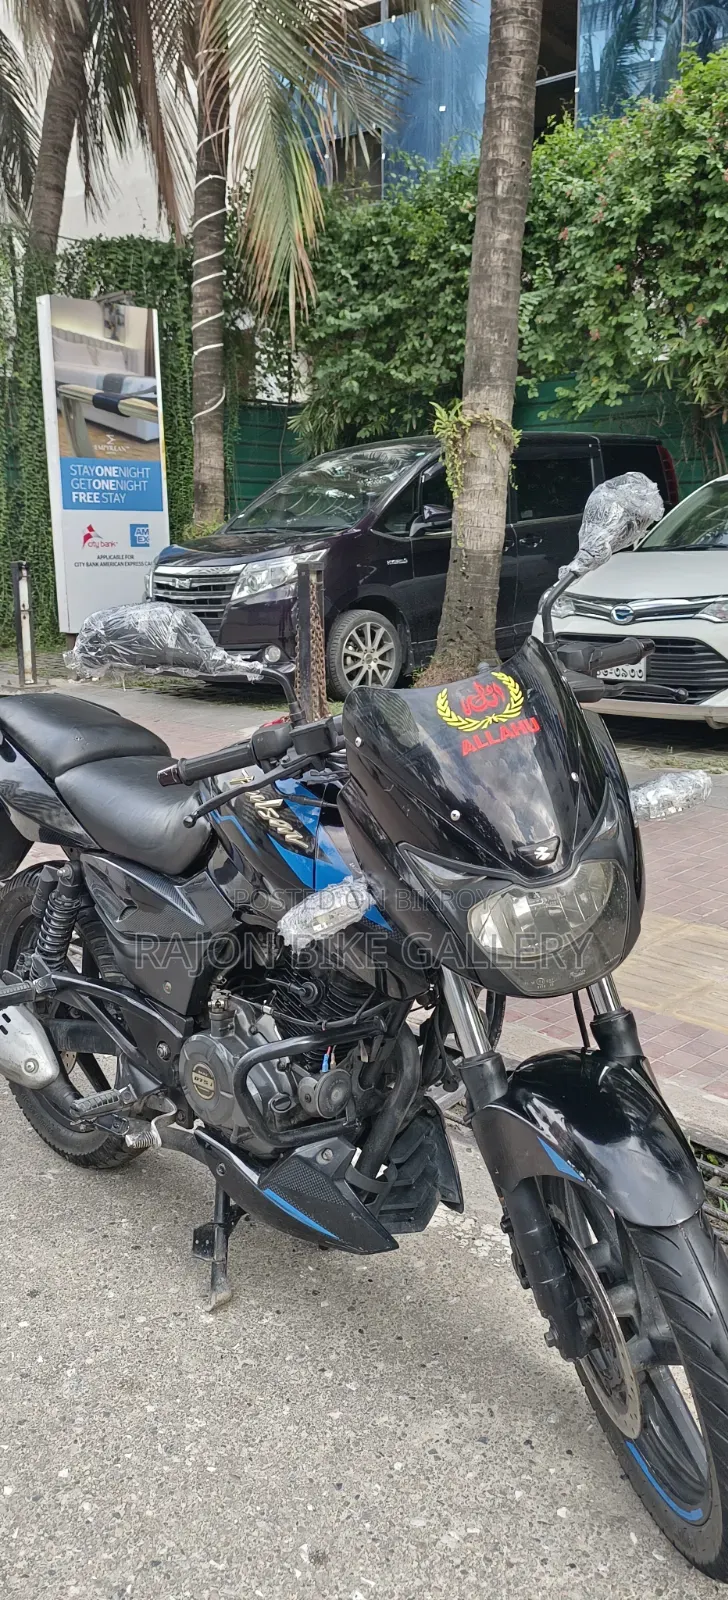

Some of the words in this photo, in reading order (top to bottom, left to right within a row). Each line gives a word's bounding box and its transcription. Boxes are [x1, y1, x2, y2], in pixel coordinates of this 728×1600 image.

[72, 492, 101, 503] FREE
[101, 493, 127, 504] STAY
[87, 541, 100, 549] city
[462, 716, 541, 757] ALLAHU
